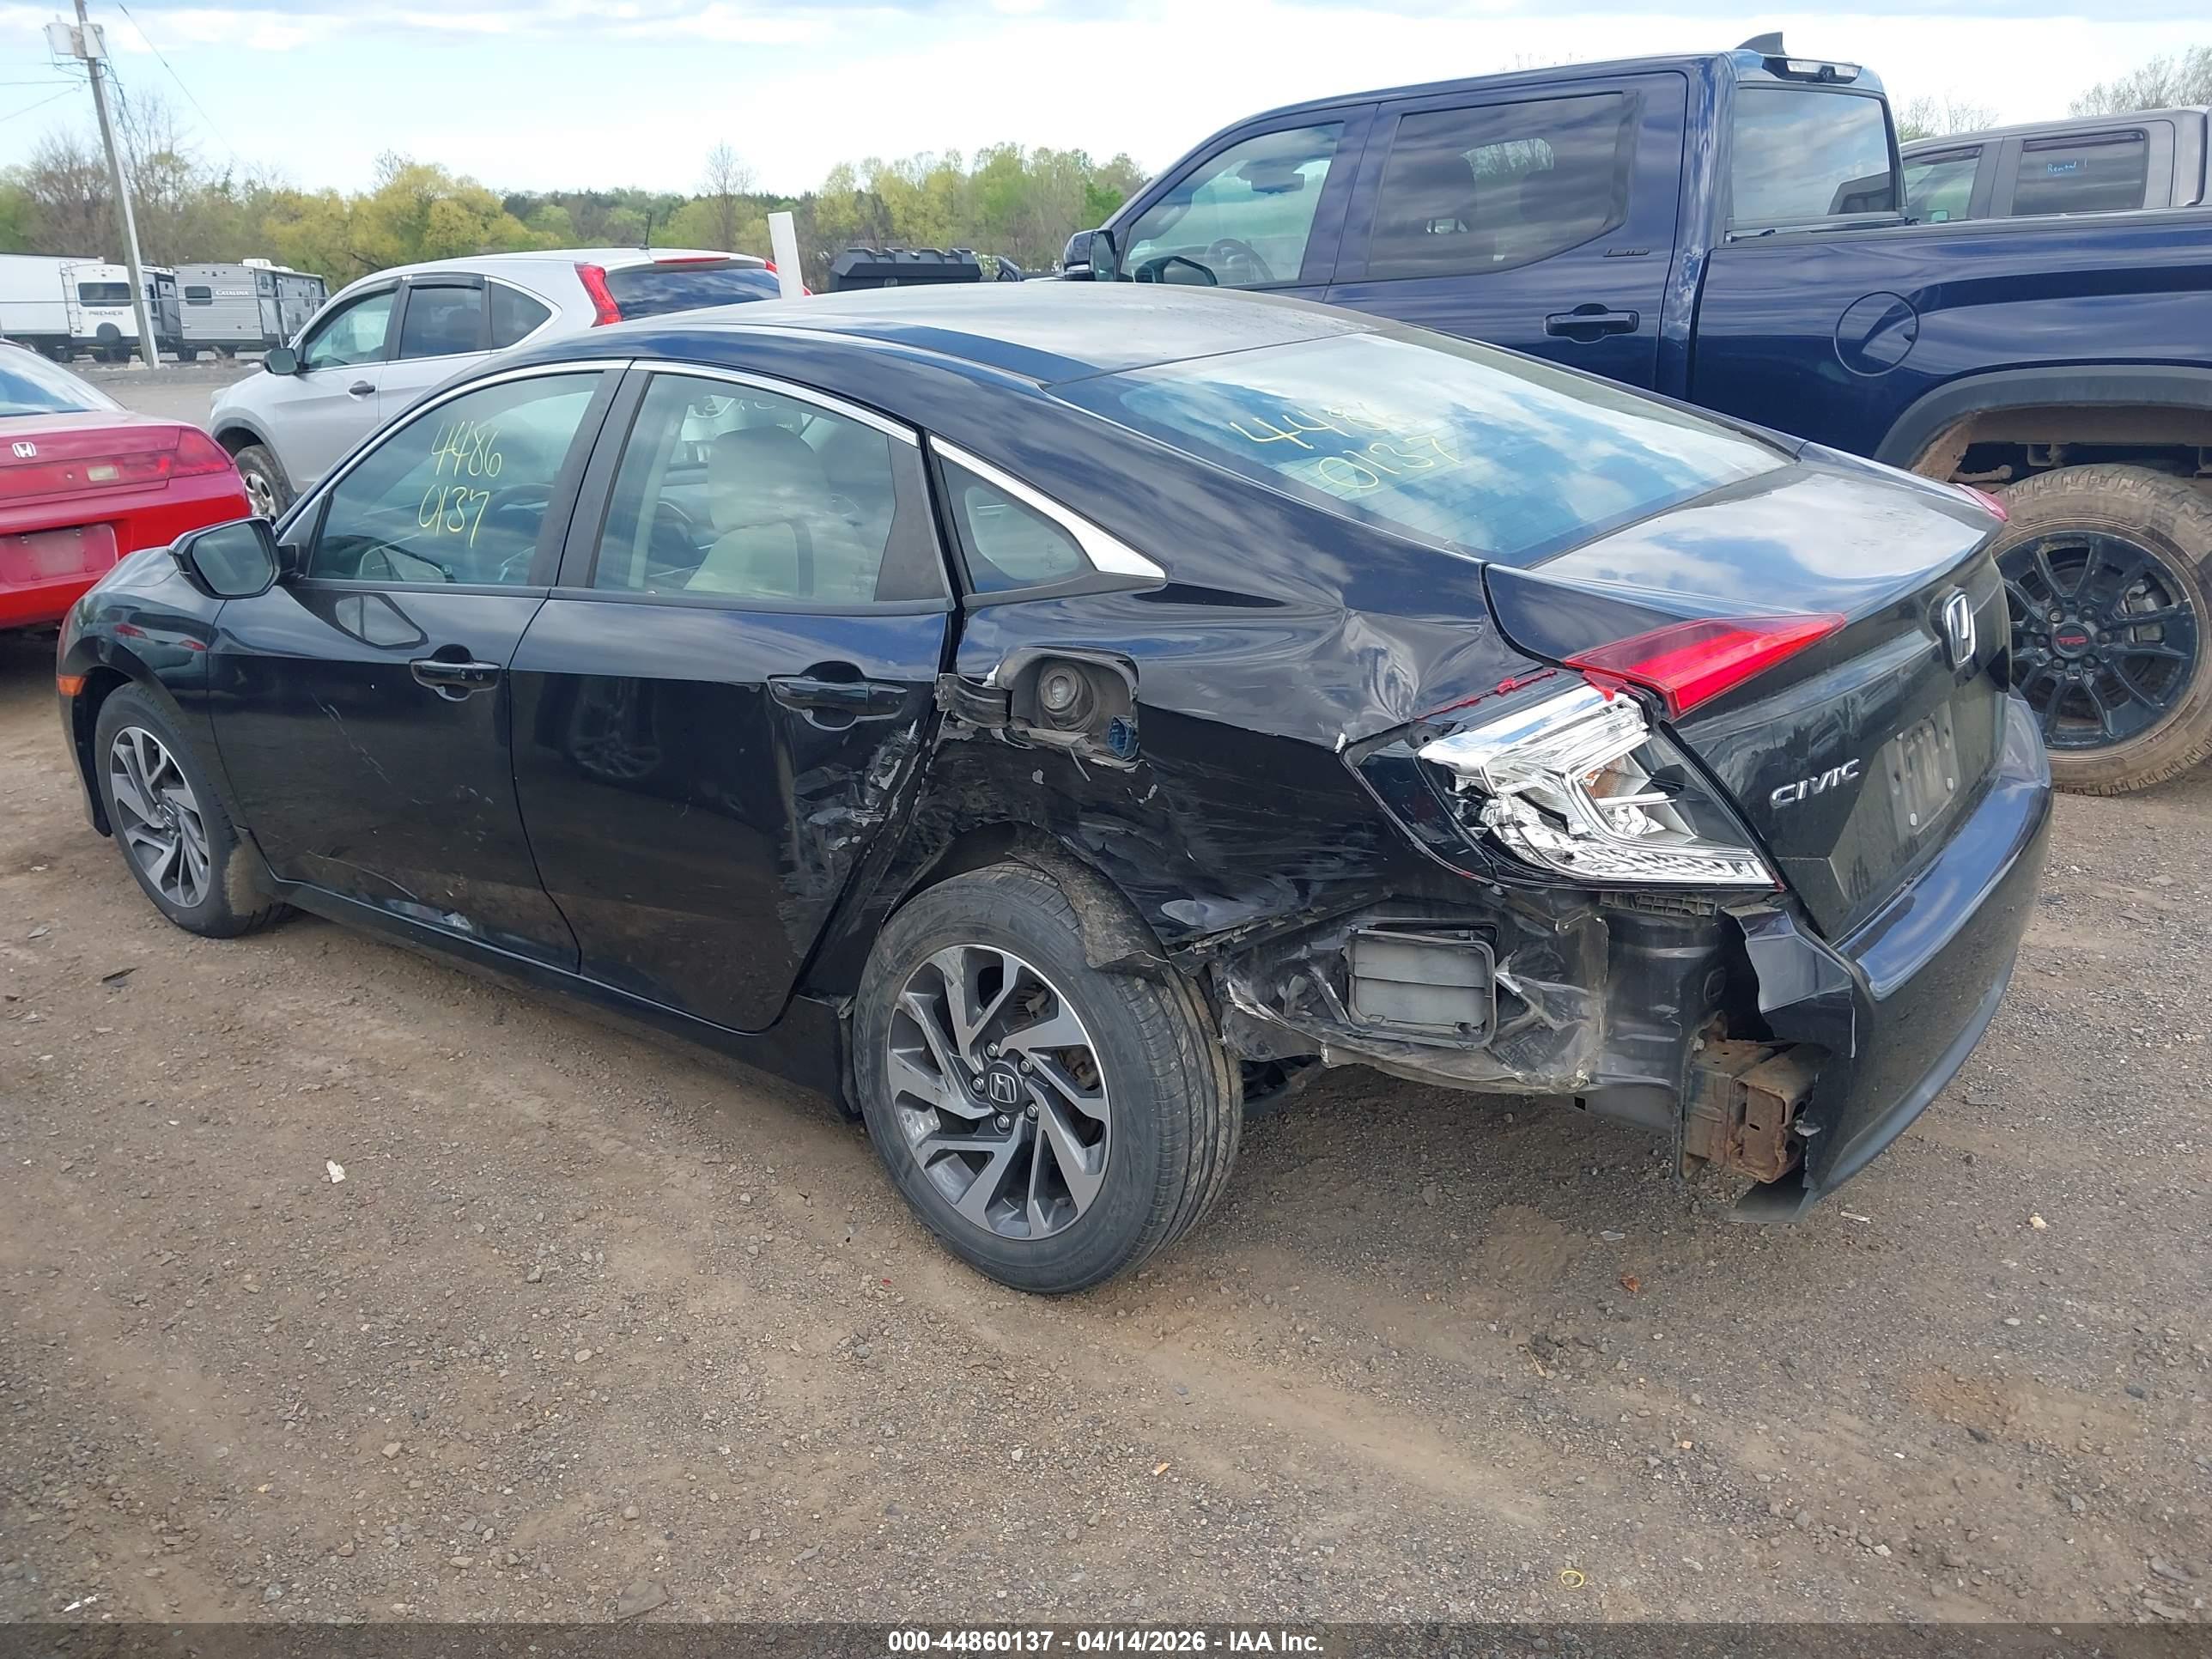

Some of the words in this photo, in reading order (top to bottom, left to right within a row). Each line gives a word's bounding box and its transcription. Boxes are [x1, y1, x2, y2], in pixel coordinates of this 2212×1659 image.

[431, 421, 502, 477] 4486
[1319, 434, 1464, 489] 0137
[418, 484, 490, 549] 0137
[1770, 758, 1860, 809] CIVIC
